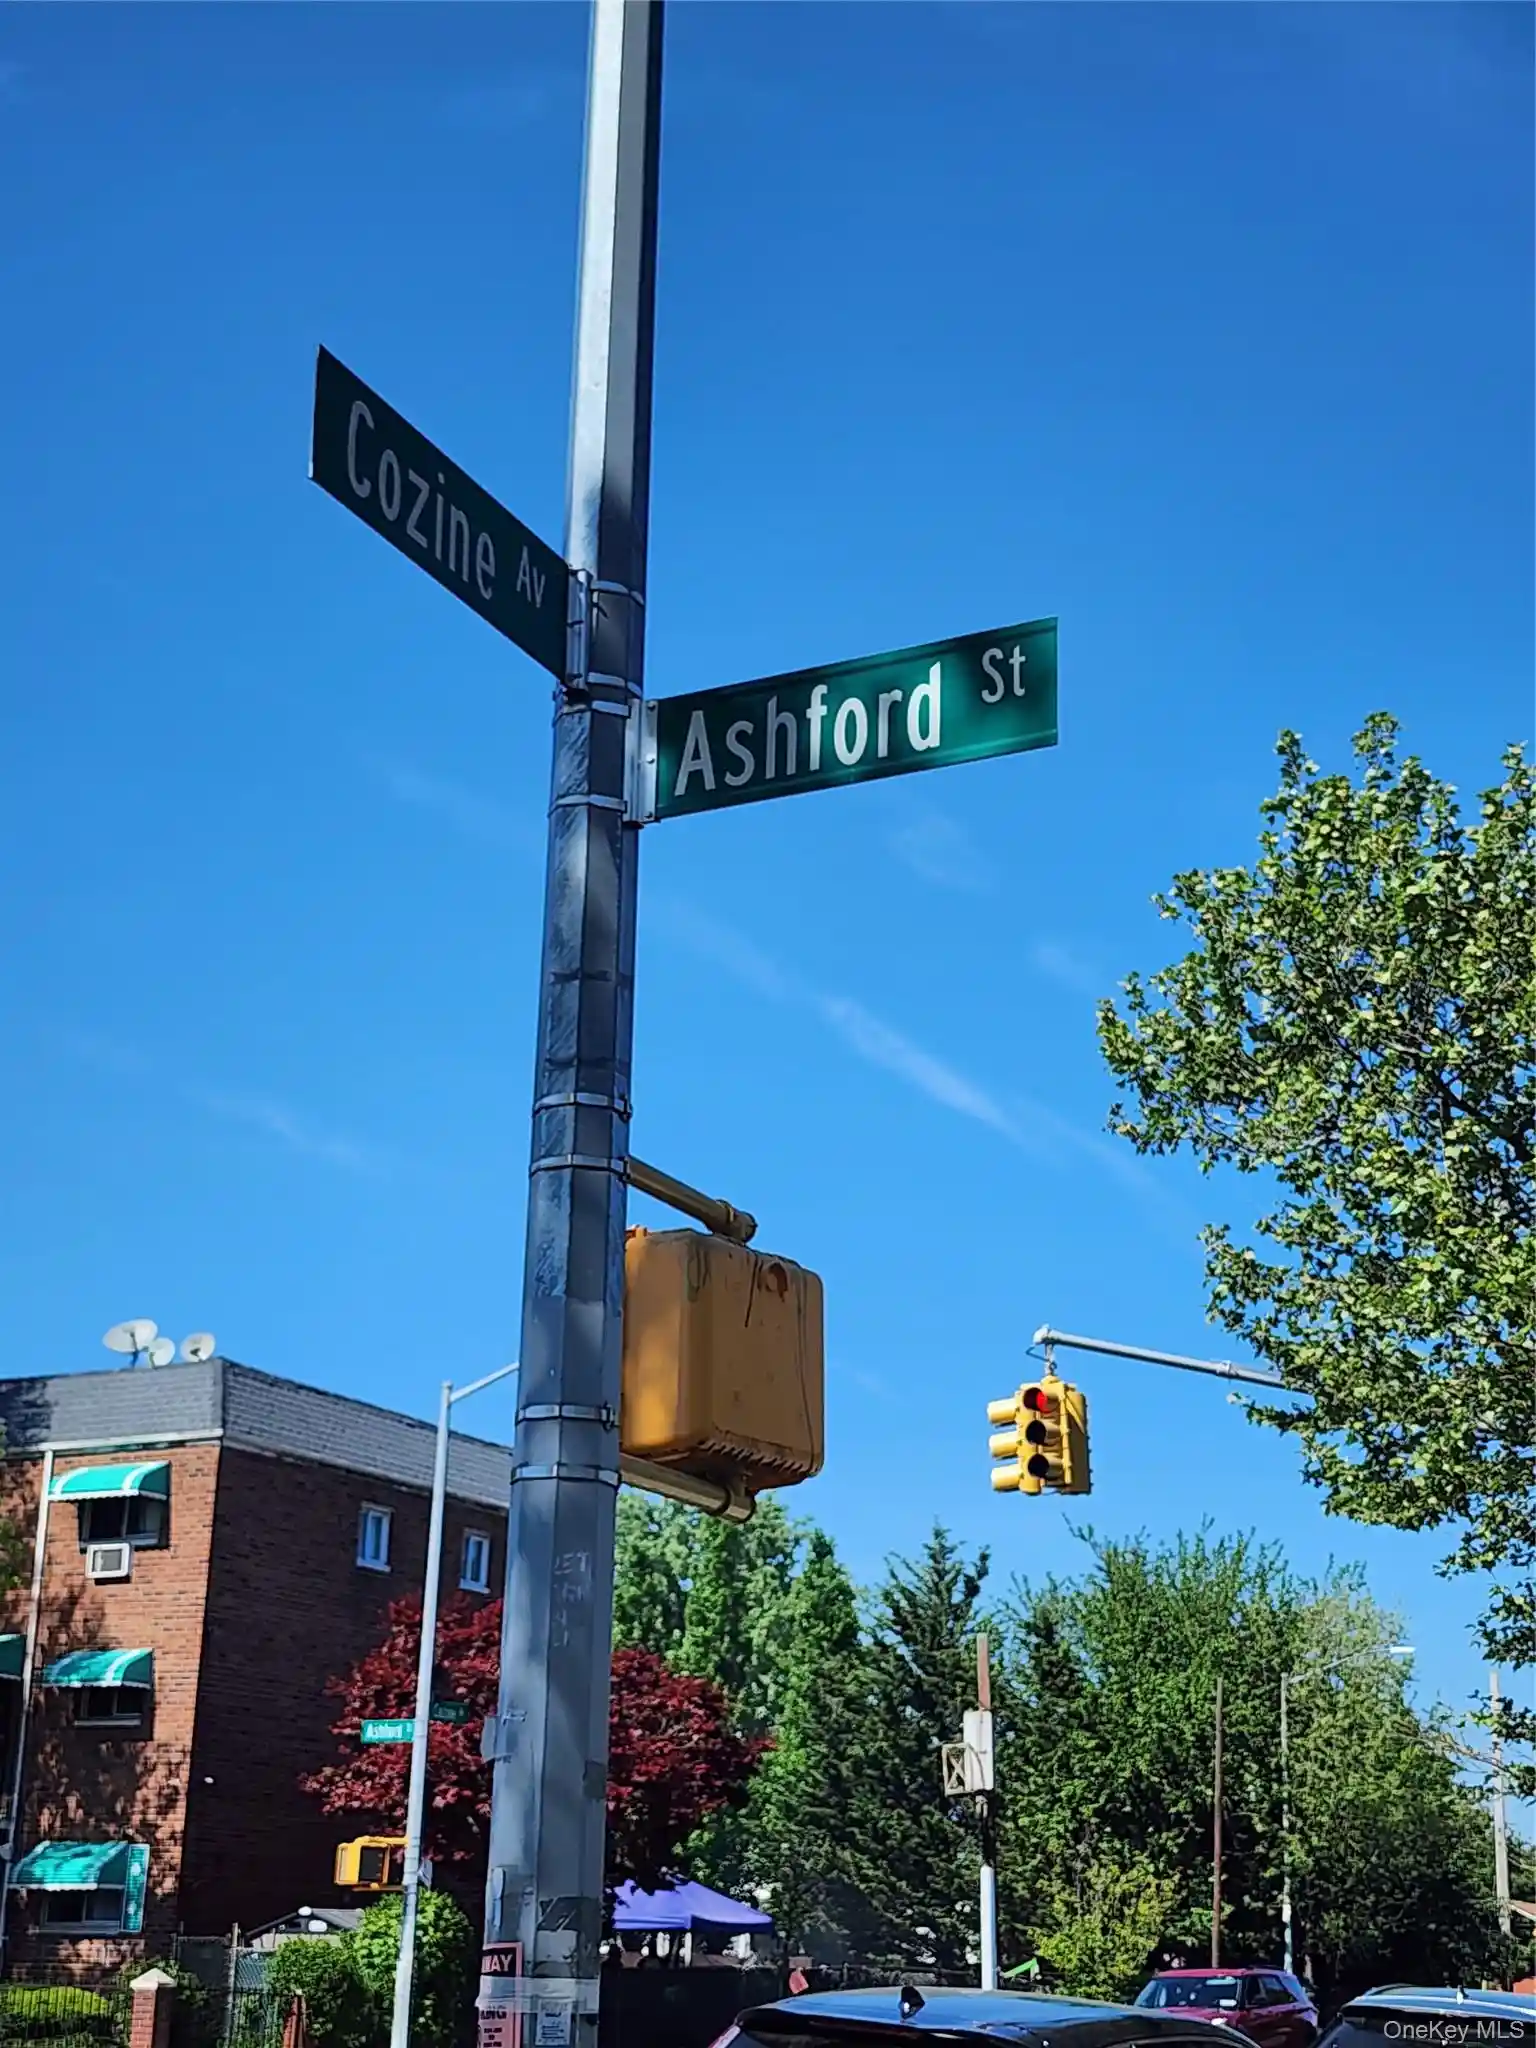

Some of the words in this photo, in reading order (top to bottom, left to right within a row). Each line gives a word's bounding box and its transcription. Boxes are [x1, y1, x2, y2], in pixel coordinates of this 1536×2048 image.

[347, 400, 496, 600] Cozine
[516, 545, 546, 608] Av
[674, 661, 942, 797] Ashford
[981, 645, 1027, 704] St
